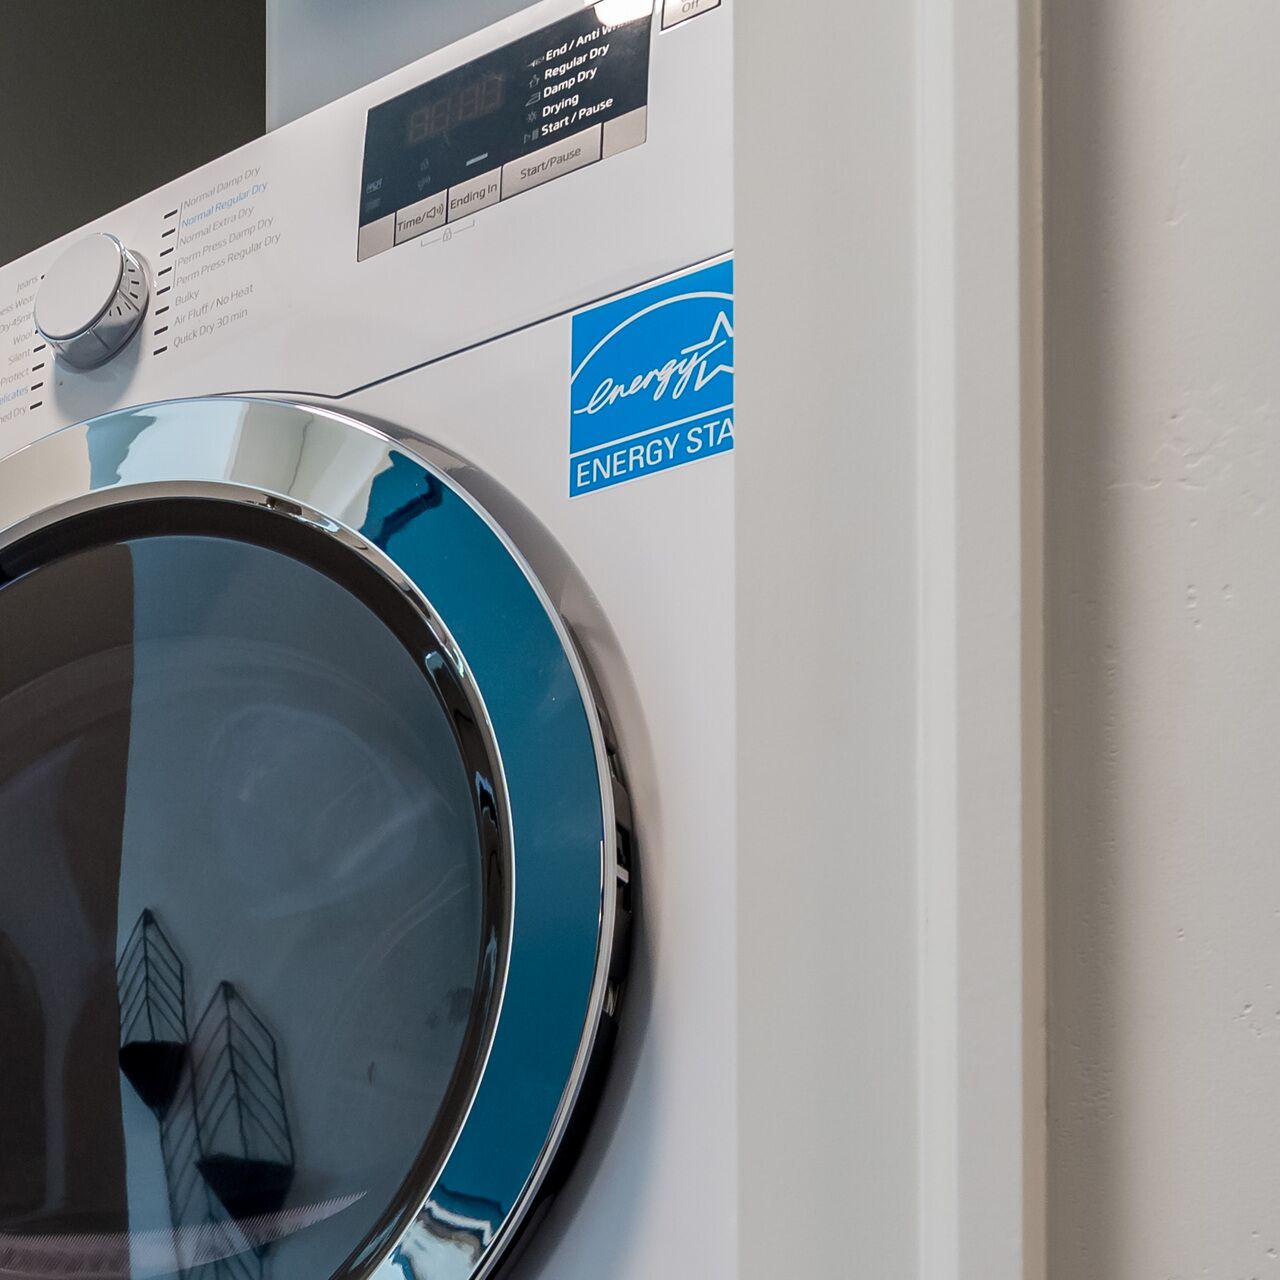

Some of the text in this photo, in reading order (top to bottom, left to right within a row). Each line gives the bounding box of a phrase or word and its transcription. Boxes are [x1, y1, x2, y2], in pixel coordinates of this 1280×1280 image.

[545, 44, 610, 79] Regular Dry
[546, 43, 567, 61] End
[576, 28, 600, 47] Anti
[544, 67, 598, 98] Damp Dry
[541, 116, 570, 136] Start
[579, 98, 614, 120] Pause
[542, 94, 579, 117] Drying
[520, 147, 582, 180] Start/Pause
[181, 182, 268, 228] Normal Regular Dry
[183, 167, 261, 209] Normal Damp Dry
[450, 183, 497, 210] Ending In
[178, 217, 274, 267] Perm Press Damp Dry
[180, 206, 254, 247] Normal Extra Dry
[176, 233, 281, 287] Perm Press Regular Dry
[17, 276, 38, 293] Jeans
[175, 290, 200, 306] Bulky
[174, 315, 186, 327] Air
[188, 303, 209, 320] Fluff
[216, 296, 230, 308] No
[230, 284, 254, 301] Heat
[13, 329, 33, 345] Wool
[173, 309, 248, 348] Quick Dry 30 min
[8, 349, 30, 365] Silent
[573, 340, 727, 415] energy
[13, 406, 27, 418] Dry
[576, 417, 735, 488] ENERGY STA
